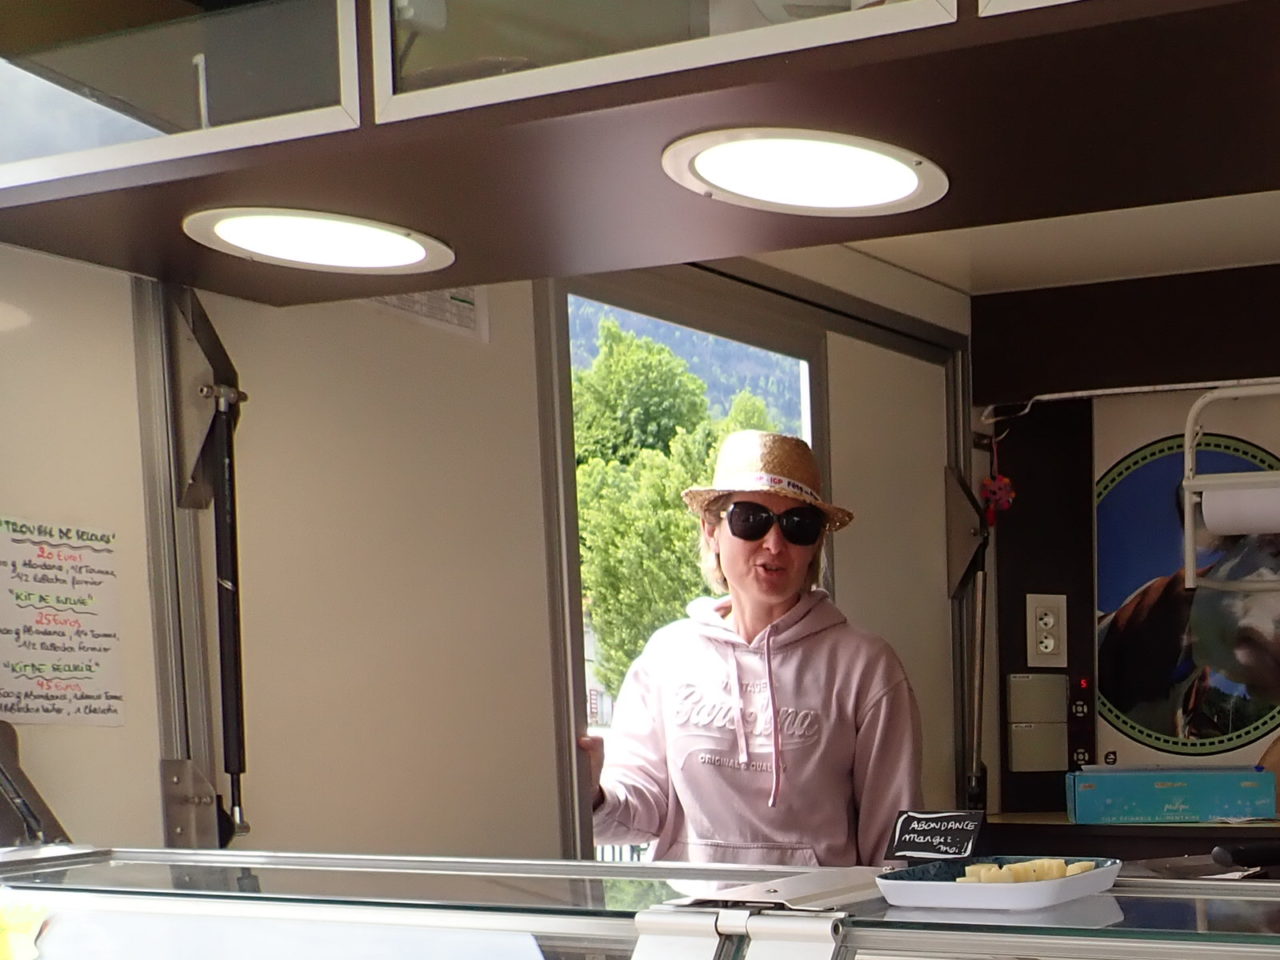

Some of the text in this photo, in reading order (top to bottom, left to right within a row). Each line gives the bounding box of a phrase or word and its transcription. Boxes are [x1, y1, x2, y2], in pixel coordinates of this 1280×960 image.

[699, 752, 740, 769] ORIGINAL
[750, 761, 788, 774] QUALY
[909, 820, 978, 831] ABONDANCE
